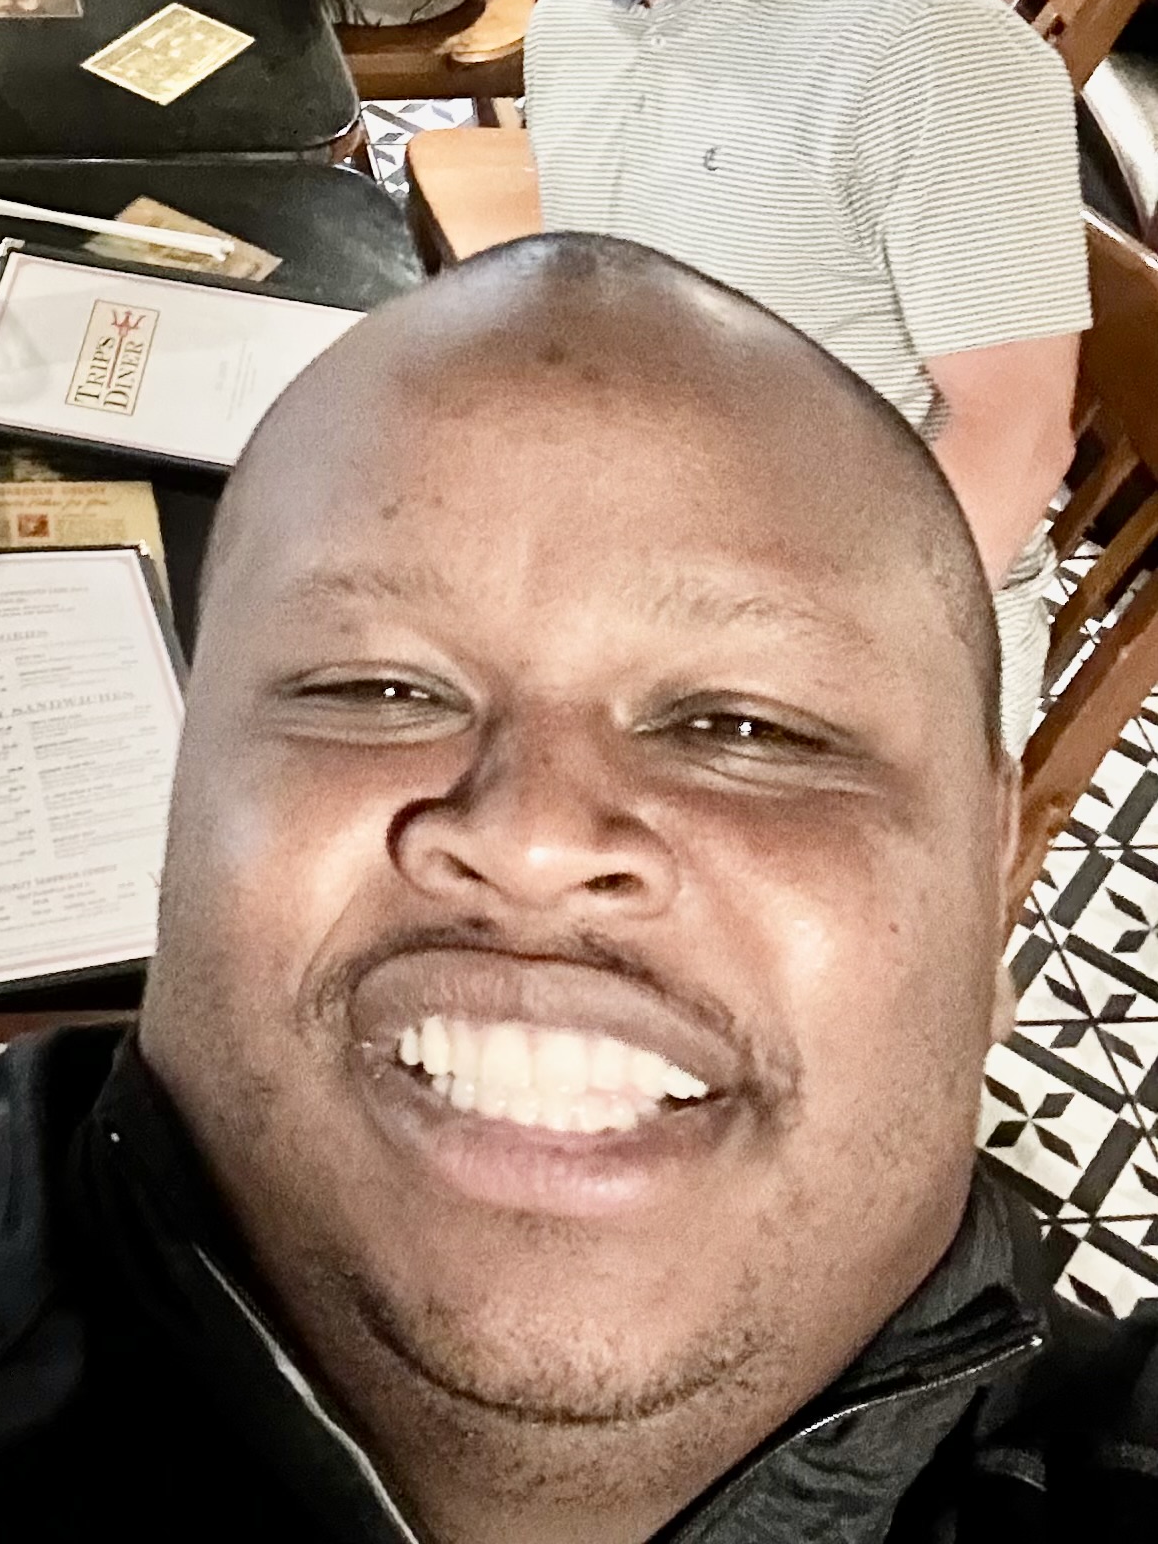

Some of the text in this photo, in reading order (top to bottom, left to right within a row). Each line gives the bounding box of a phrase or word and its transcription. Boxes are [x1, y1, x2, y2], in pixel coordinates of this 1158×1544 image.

[74, 336, 115, 402] TRIP'S
[103, 340, 144, 410] DINER
[10, 689, 136, 719] SANDWICHES
